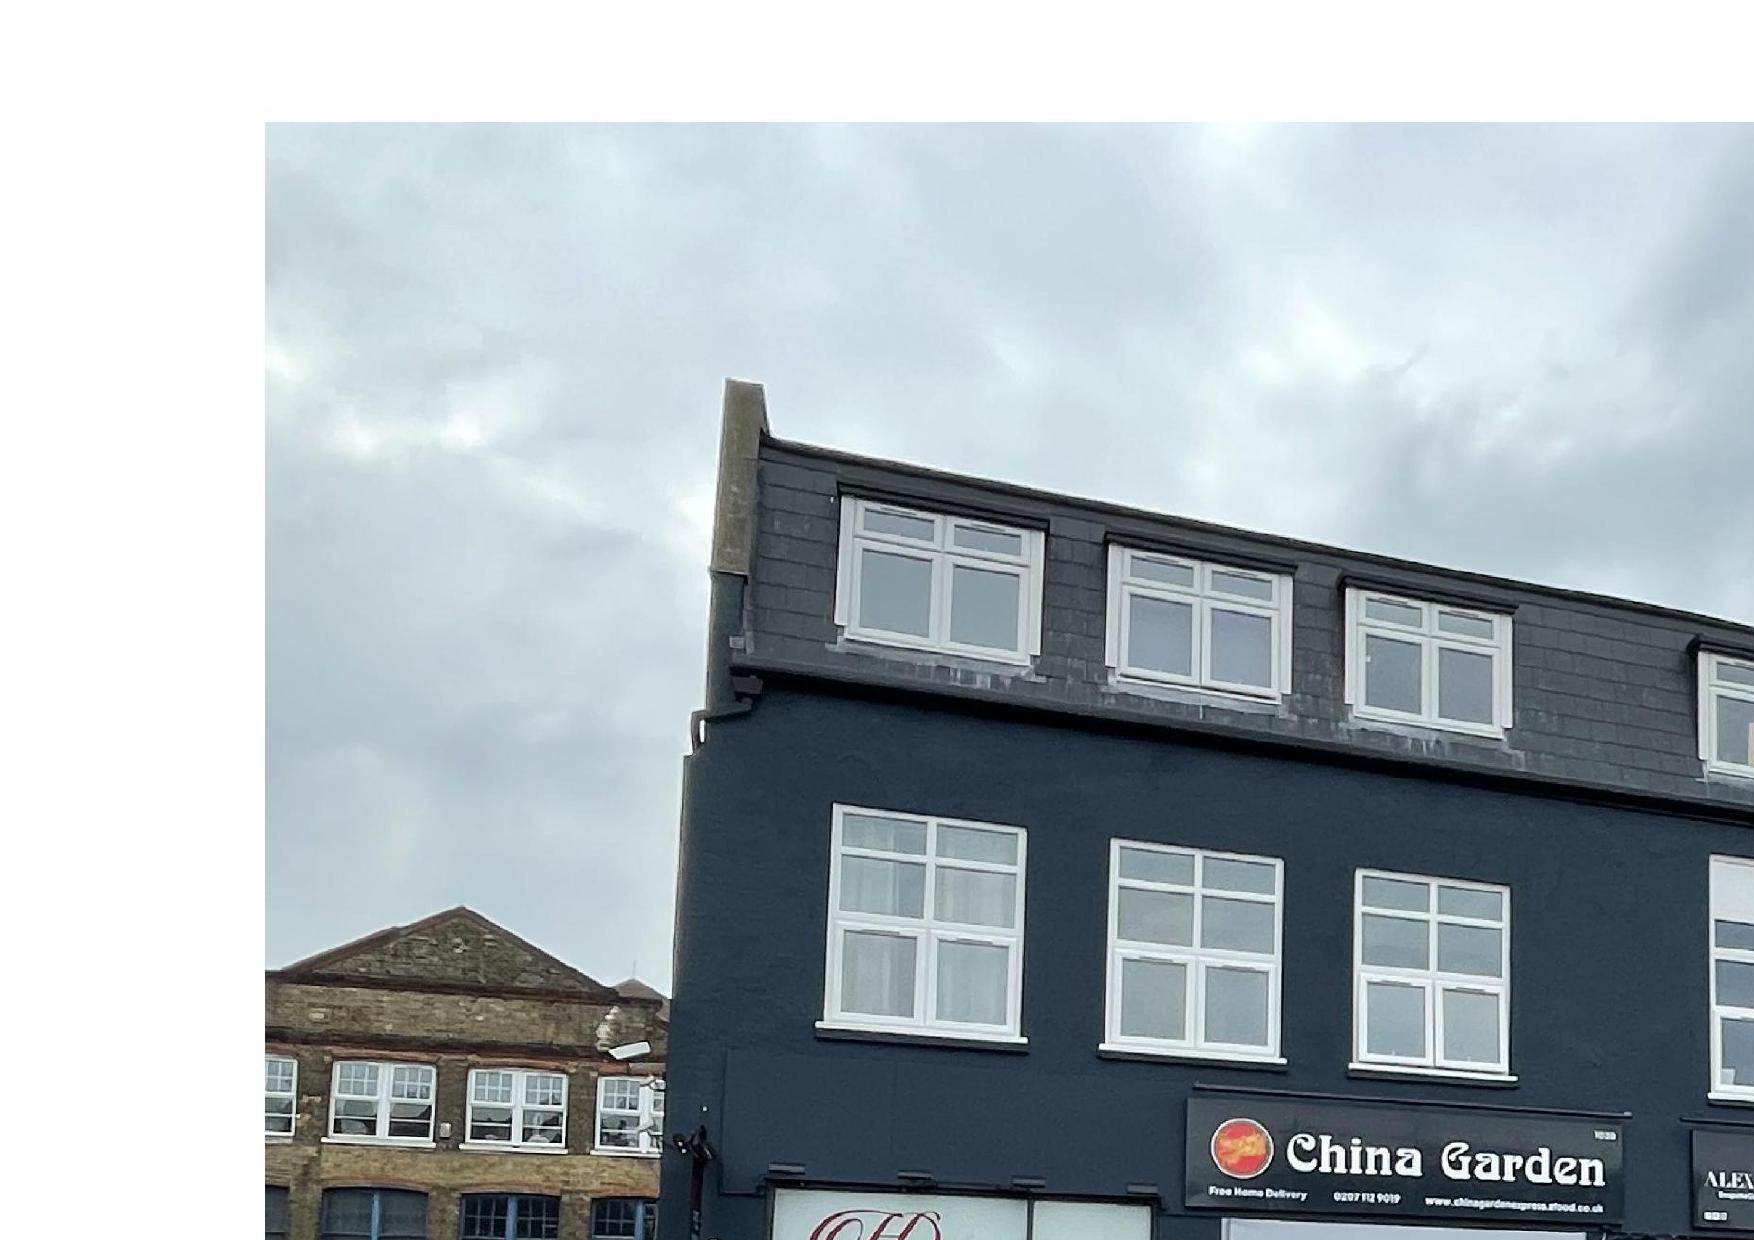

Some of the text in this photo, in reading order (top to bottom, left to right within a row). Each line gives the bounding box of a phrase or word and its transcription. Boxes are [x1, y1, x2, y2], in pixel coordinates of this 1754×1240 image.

[1286, 1132, 1606, 1188] China Garden
[1704, 1170, 1754, 1190] ALEX
[1208, 1185, 1309, 1202] Free Home Delivery
